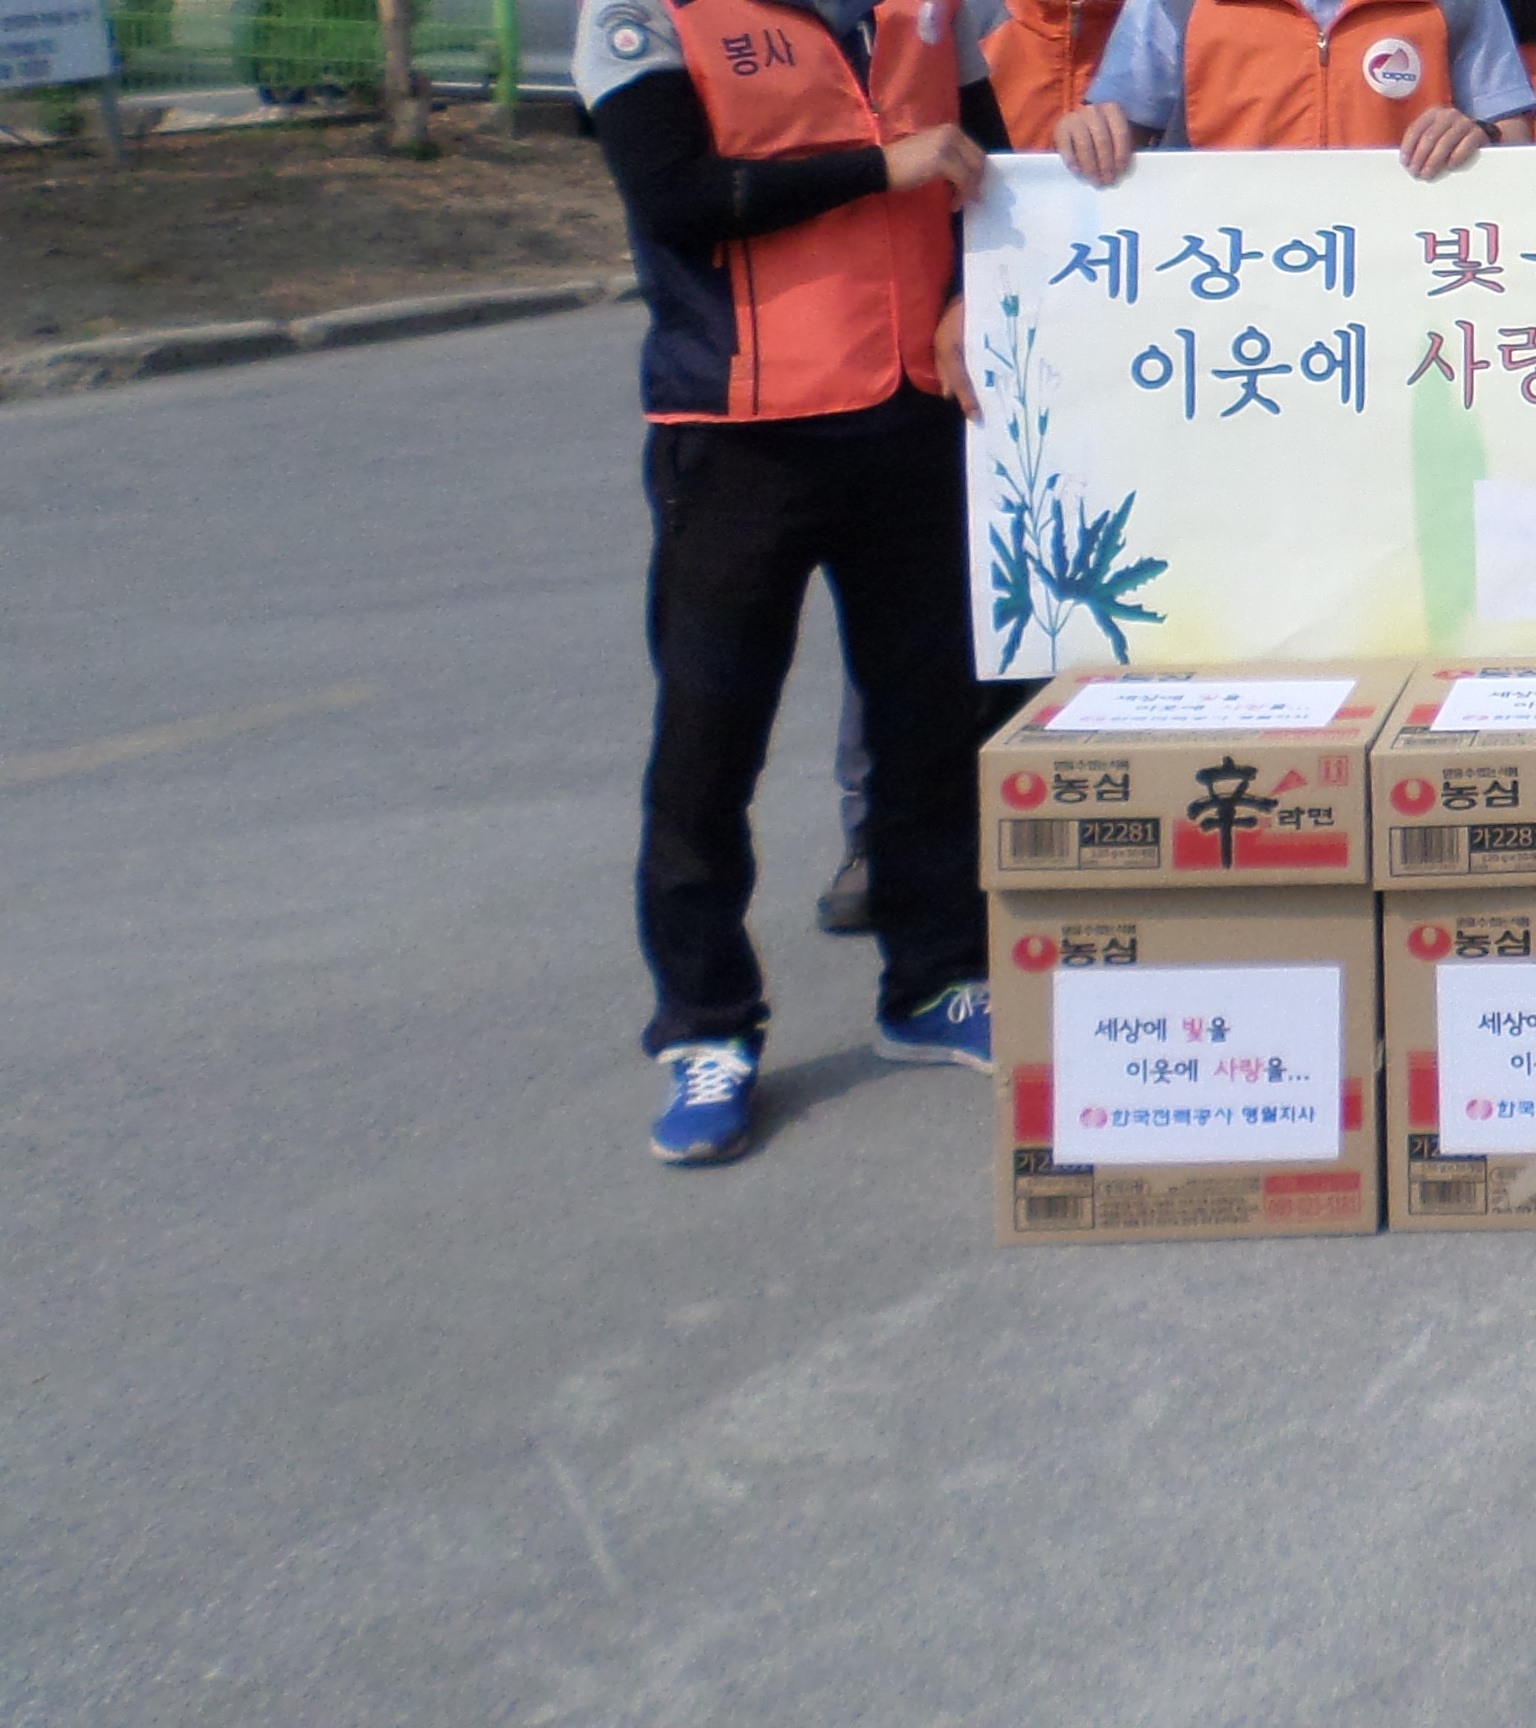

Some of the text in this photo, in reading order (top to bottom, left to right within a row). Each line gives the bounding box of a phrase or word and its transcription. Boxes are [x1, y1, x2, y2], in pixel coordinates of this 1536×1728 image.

[720, 28, 797, 77] 봉사
[1048, 223, 1358, 302] 세상에
[1129, 320, 1370, 423] 이웃에
[1052, 772, 1130, 803] 농심
[1441, 779, 1520, 811] 농심
[1186, 755, 1336, 870] 辛 라면
[1083, 821, 1155, 844] 가2281
[1060, 937, 1138, 967] 농심
[1453, 929, 1532, 959] 농심
[1094, 1015, 1231, 1044] 세상에 빛을
[1125, 1057, 1199, 1085] 이웃에
[1110, 1104, 1317, 1128] 한국전력공사 영월지사
